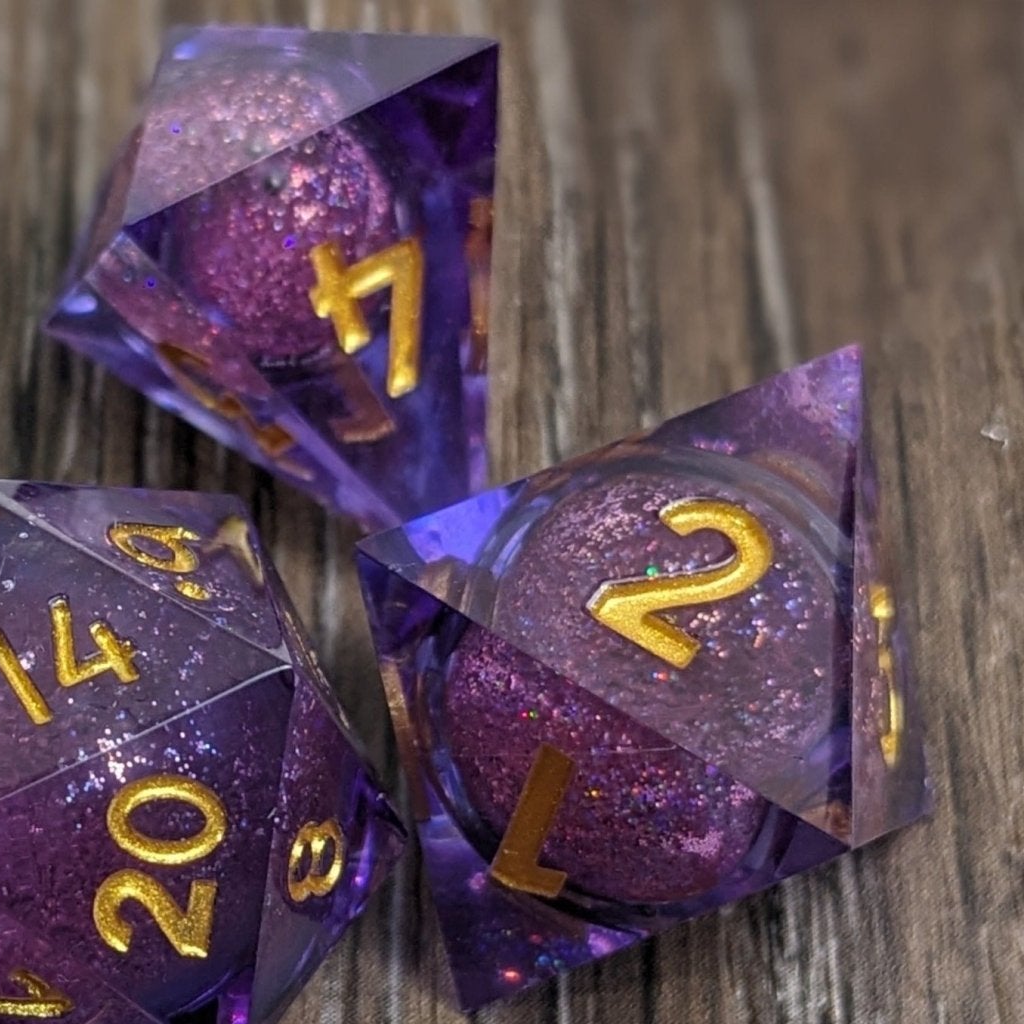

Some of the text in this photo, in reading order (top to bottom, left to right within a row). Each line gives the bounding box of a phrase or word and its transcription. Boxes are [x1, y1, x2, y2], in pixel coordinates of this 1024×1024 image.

[308, 237, 424, 398] 4
[585, 497, 774, 670] 2
[93, 775, 228, 959] 20
[287, 818, 347, 903] 8
